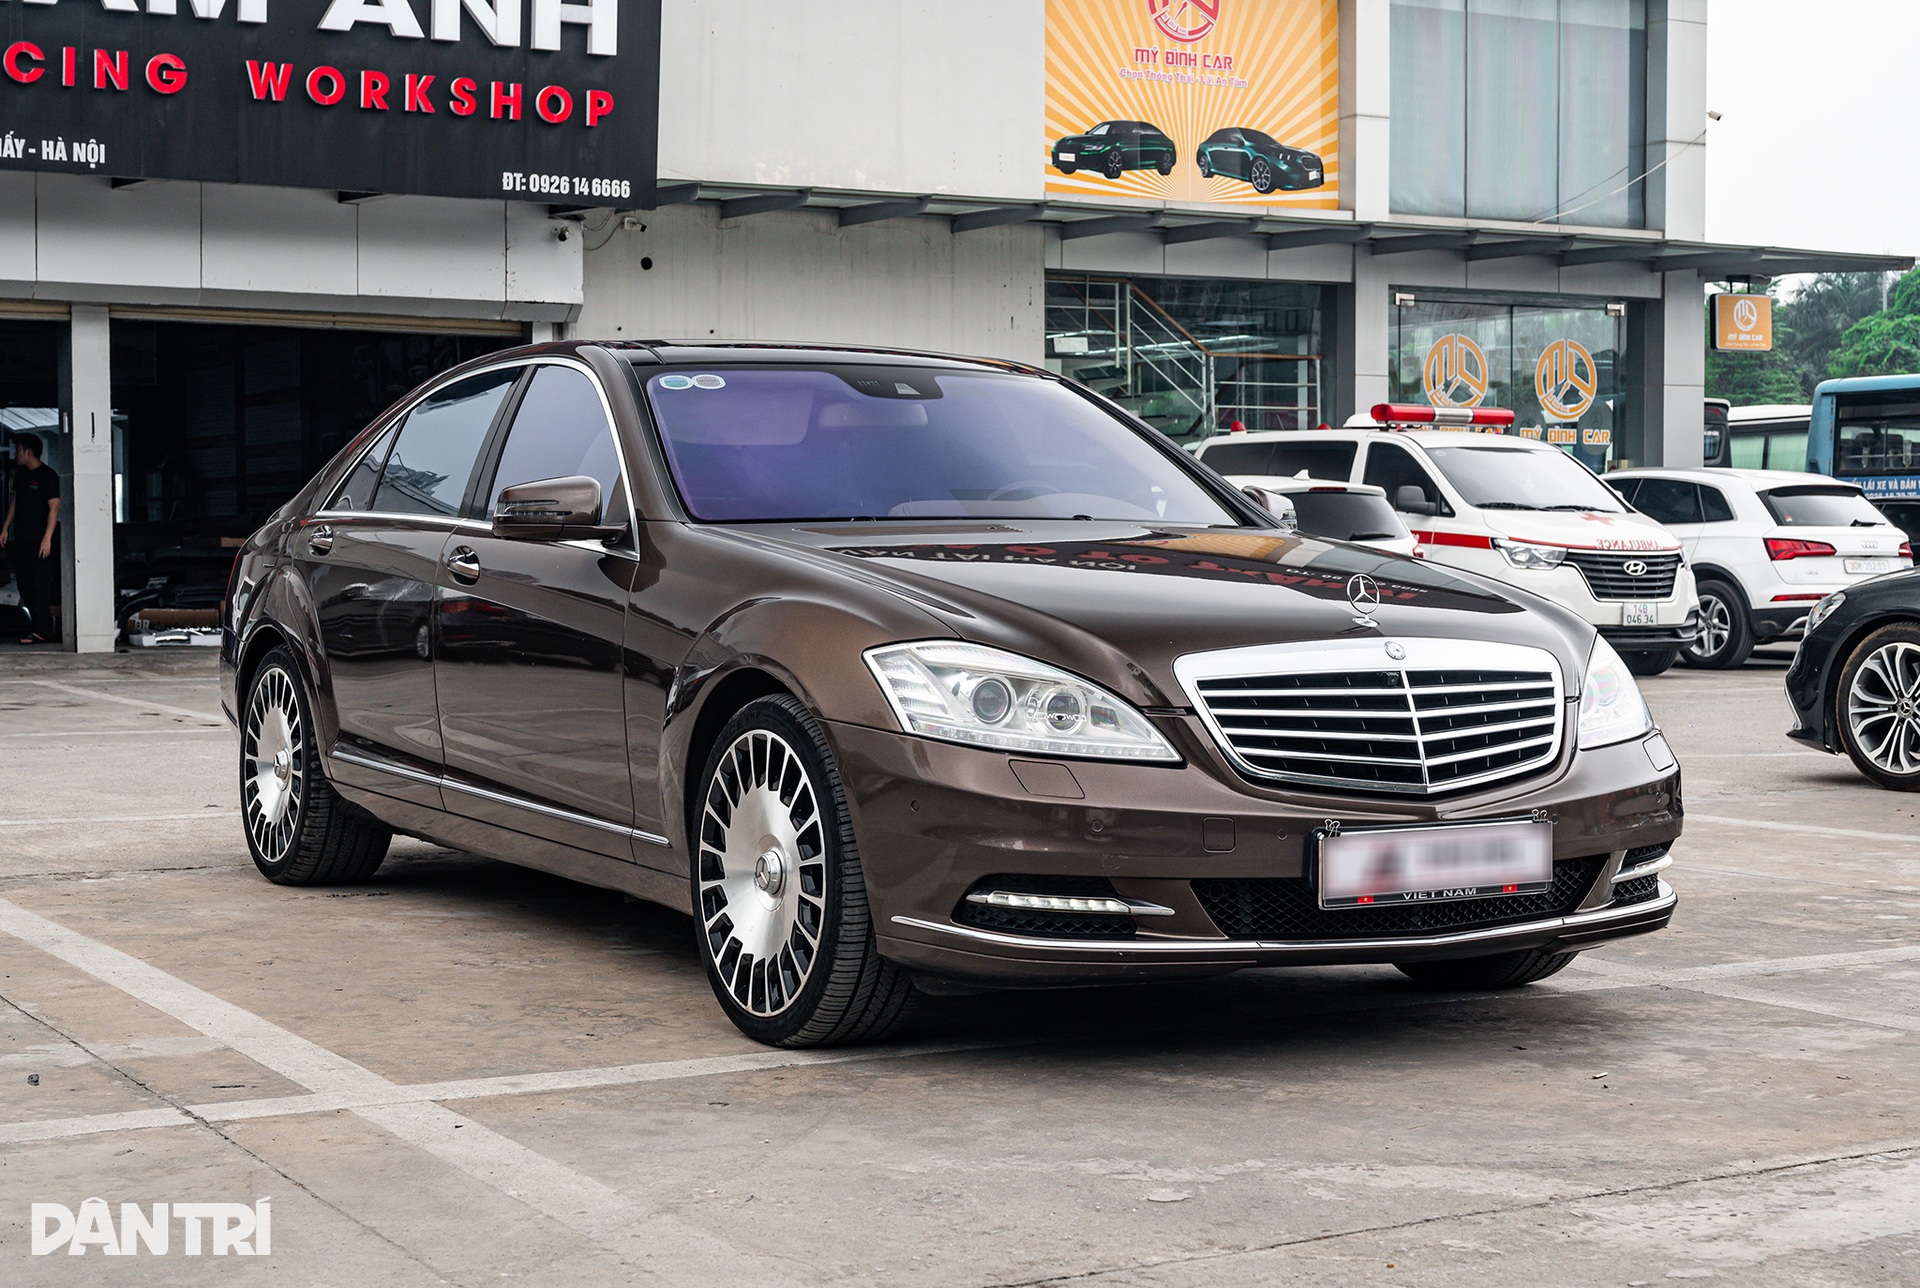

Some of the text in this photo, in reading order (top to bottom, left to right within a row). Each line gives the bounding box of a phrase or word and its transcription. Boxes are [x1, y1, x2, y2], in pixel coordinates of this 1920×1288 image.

[1202, 54, 1233, 70] CAR
[3, 40, 614, 127] CING WORKSHOP
[41, 136, 68, 161] HÀ
[72, 138, 106, 169] NỘI
[502, 171, 631, 199] ĐT: 0926 14 6666
[1583, 428, 1610, 445] CAR
[1876, 480, 1887, 490] XE
[1402, 887, 1477, 900] VIET NAM
